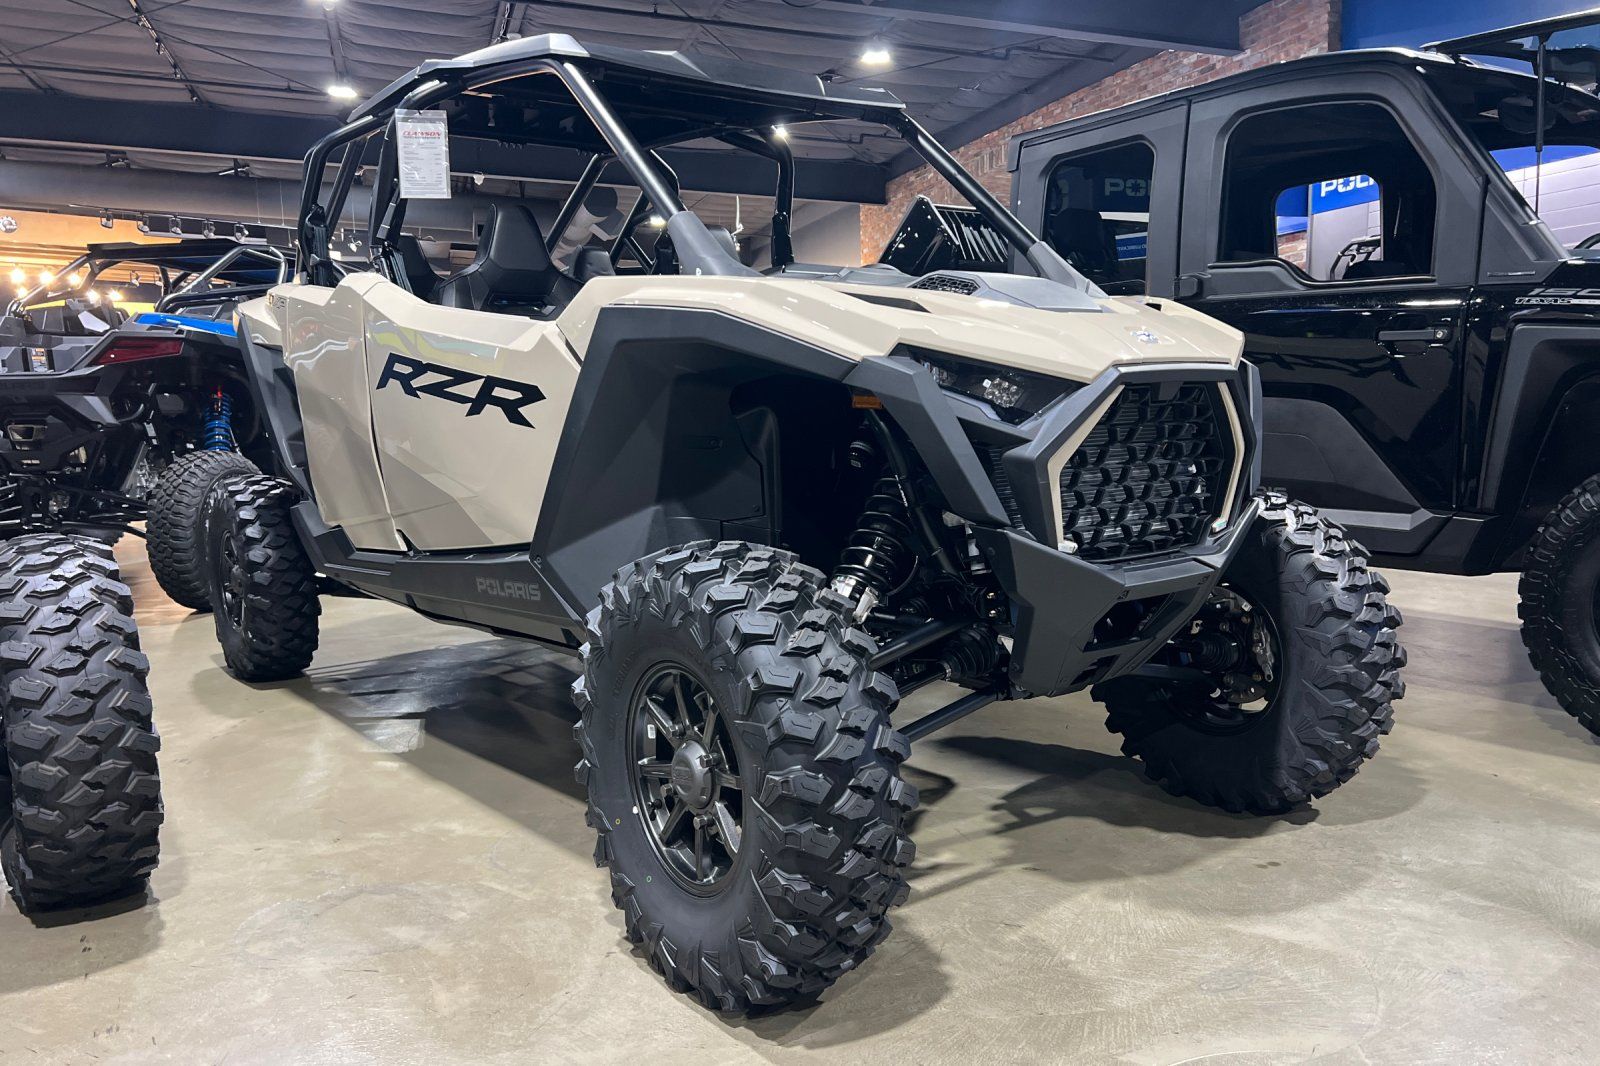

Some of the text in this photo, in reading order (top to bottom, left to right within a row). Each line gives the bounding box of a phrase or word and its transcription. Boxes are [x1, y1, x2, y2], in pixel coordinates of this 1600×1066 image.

[1104, 178, 1151, 197] PO
[1514, 296, 1574, 305] TEXAS
[376, 352, 547, 429] RZR
[475, 576, 541, 601] POLARIS
